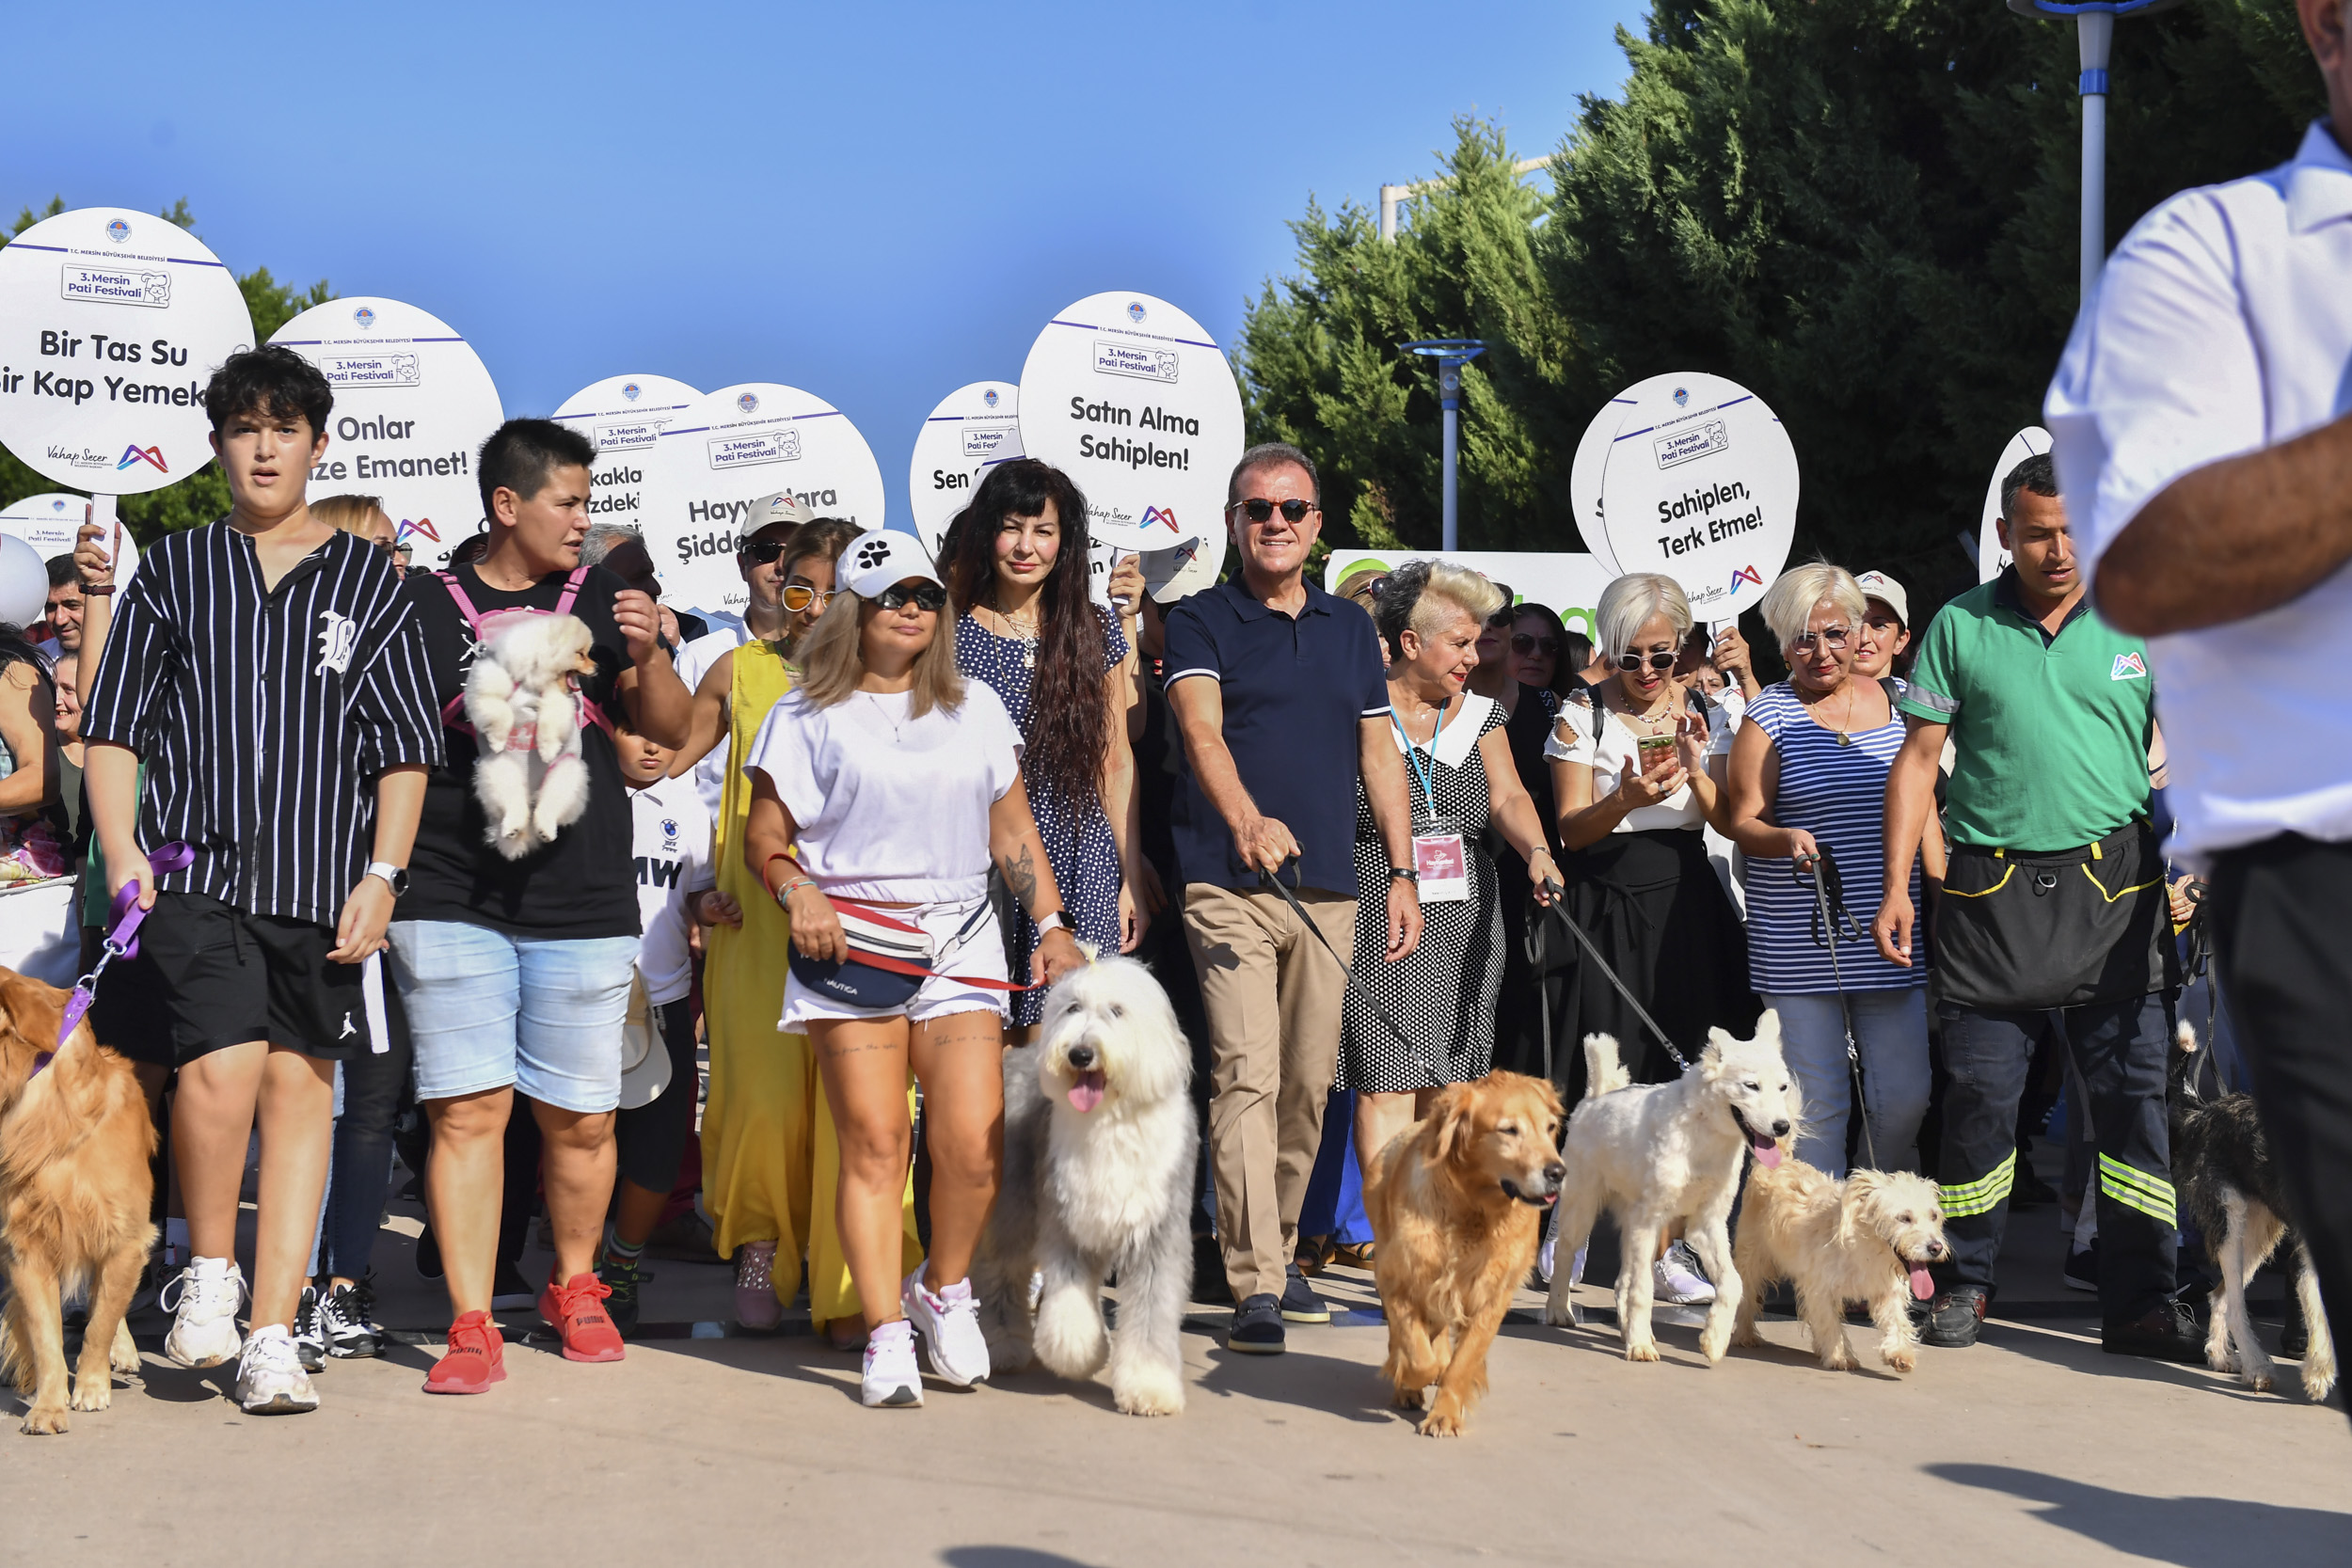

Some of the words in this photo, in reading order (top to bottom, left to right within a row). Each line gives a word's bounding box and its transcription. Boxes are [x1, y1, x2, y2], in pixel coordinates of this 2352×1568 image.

[103, 251, 136, 260] BÜYÜKŞEHİR
[92, 274, 131, 285] Mersin
[68, 282, 91, 293] Pati
[95, 285, 142, 298] Festivali
[40, 329, 82, 357] Bir
[90, 334, 141, 363] Tas
[151, 339, 187, 367] Su
[1117, 350, 1147, 361] Mersin
[346, 359, 382, 370] Mersin
[1099, 357, 1118, 367] Pati
[1120, 360, 1156, 373] Festivali
[326, 372, 348, 381] Pati
[351, 370, 394, 380] Festivali
[0, 366, 24, 393] ir
[33, 370, 94, 405] Kap
[103, 375, 207, 407] Yemek
[1070, 396, 1132, 427] Satın
[1138, 405, 1200, 436] Alma
[337, 414, 416, 441] Onlar
[617, 426, 647, 436] Mersin
[600, 437, 618, 446] Pati
[621, 434, 657, 445] Festivali
[733, 439, 766, 451] Mersin
[967, 441, 981, 450] Pati
[1675, 434, 1700, 447] Mersin
[47, 445, 80, 466] Vahap
[715, 452, 735, 462] Pati
[737, 447, 777, 460] Festivali
[1079, 434, 1189, 471] Sahiplen!
[1661, 450, 1677, 462] Pati
[1678, 438, 1709, 456] Festivali
[357, 451, 469, 479] Emanet!
[590, 466, 644, 487] kakla
[933, 469, 969, 490] Sen
[1658, 481, 1751, 523] Sahiplen,
[1658, 526, 1706, 559] Terk
[1708, 505, 1764, 544] Etme!
